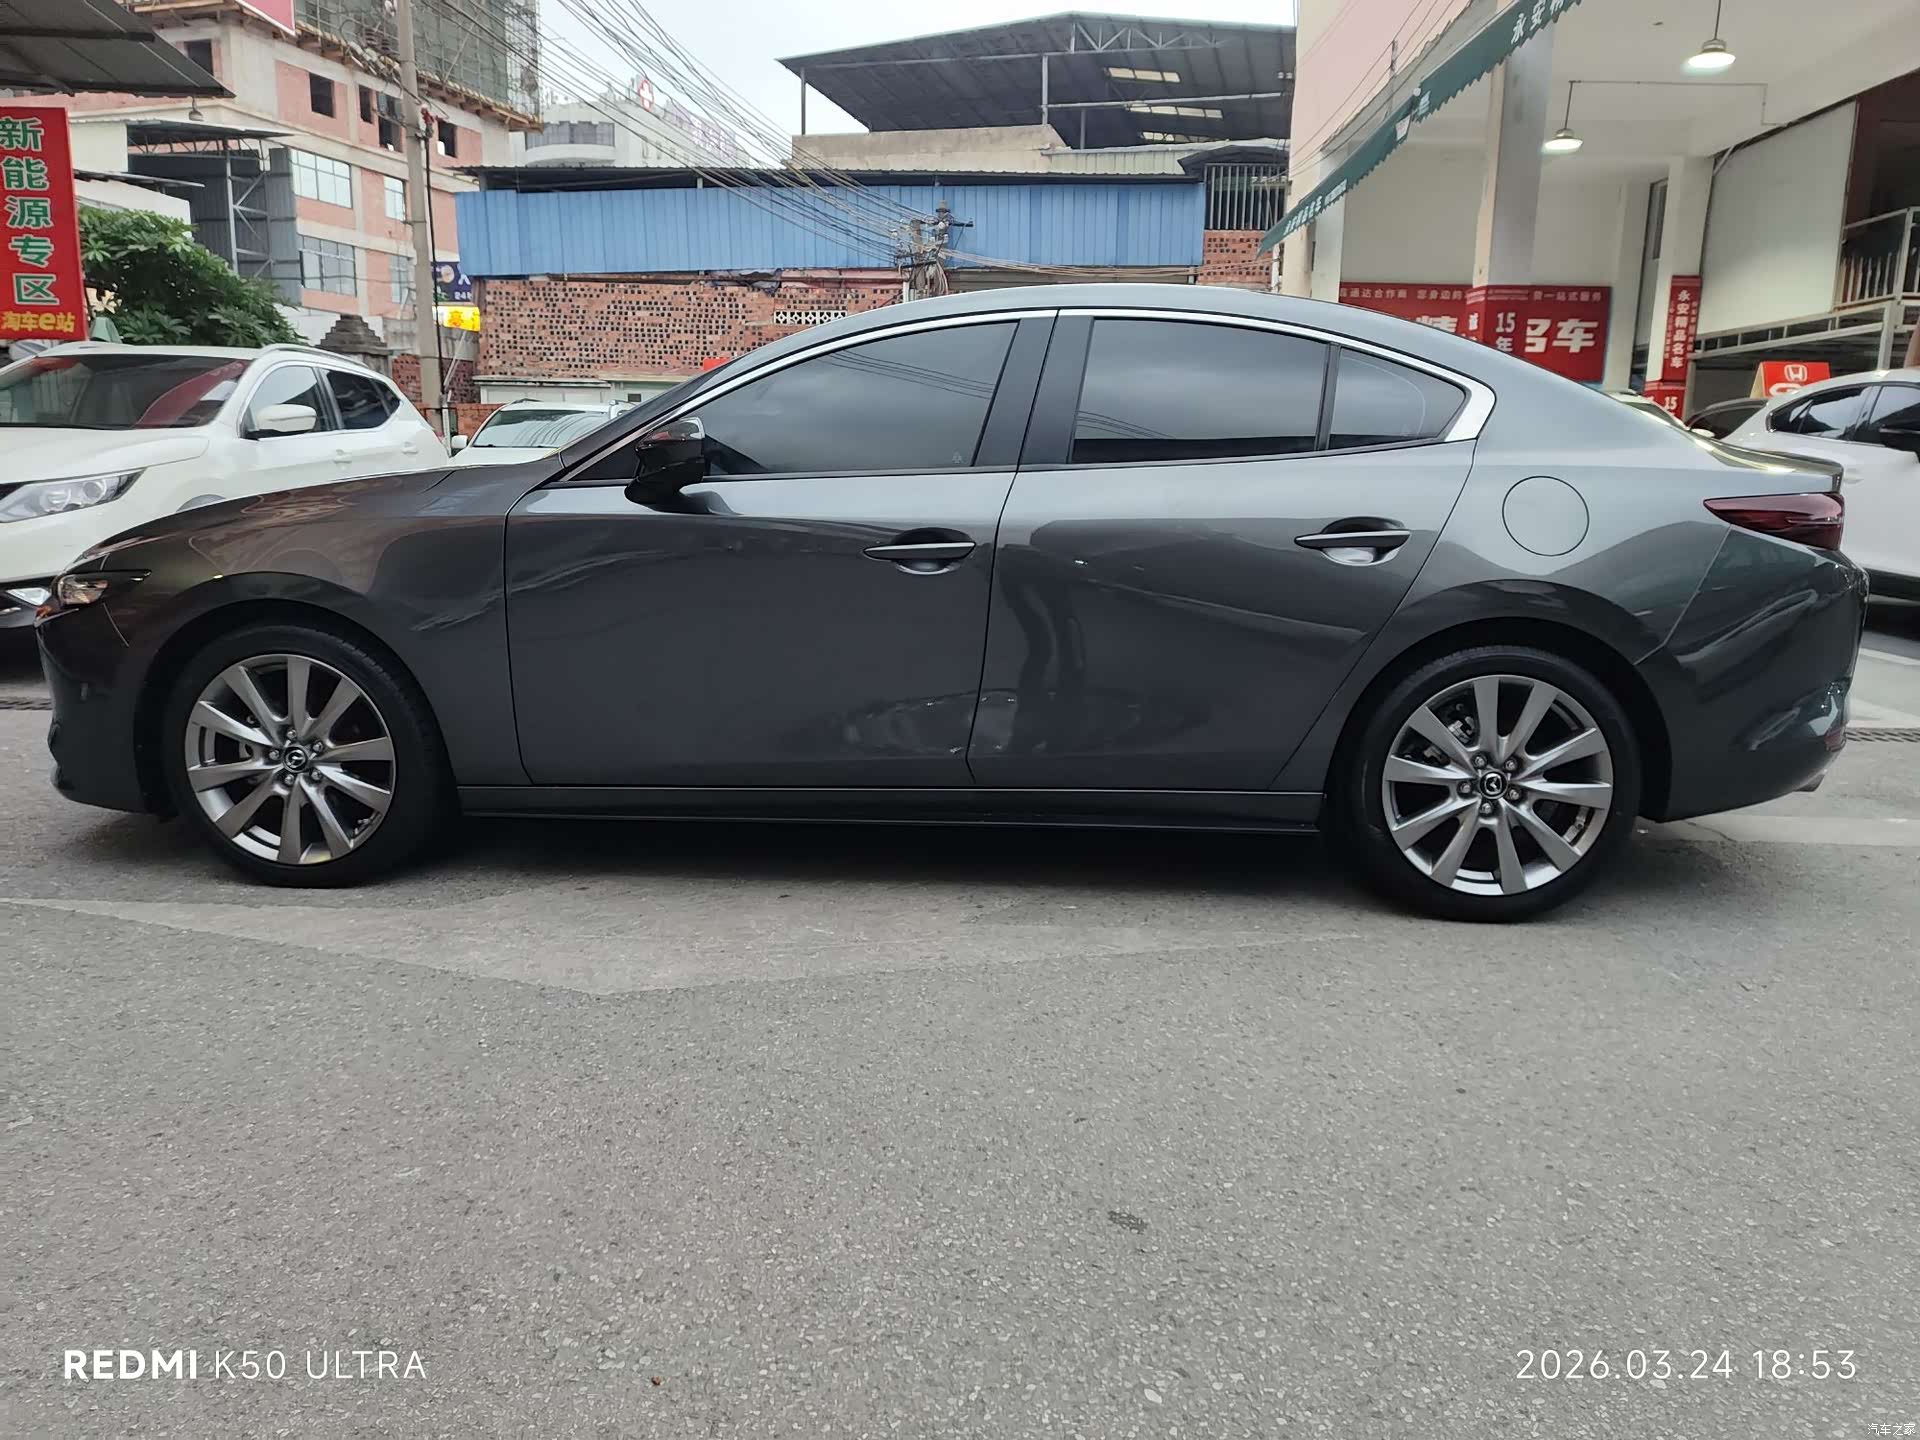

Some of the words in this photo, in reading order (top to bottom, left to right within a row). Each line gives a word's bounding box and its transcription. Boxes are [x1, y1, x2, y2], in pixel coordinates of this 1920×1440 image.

[0, 116, 60, 306] 新能源专区
[2, 311, 75, 334] 淘车e站
[1495, 312, 1516, 333] 15
